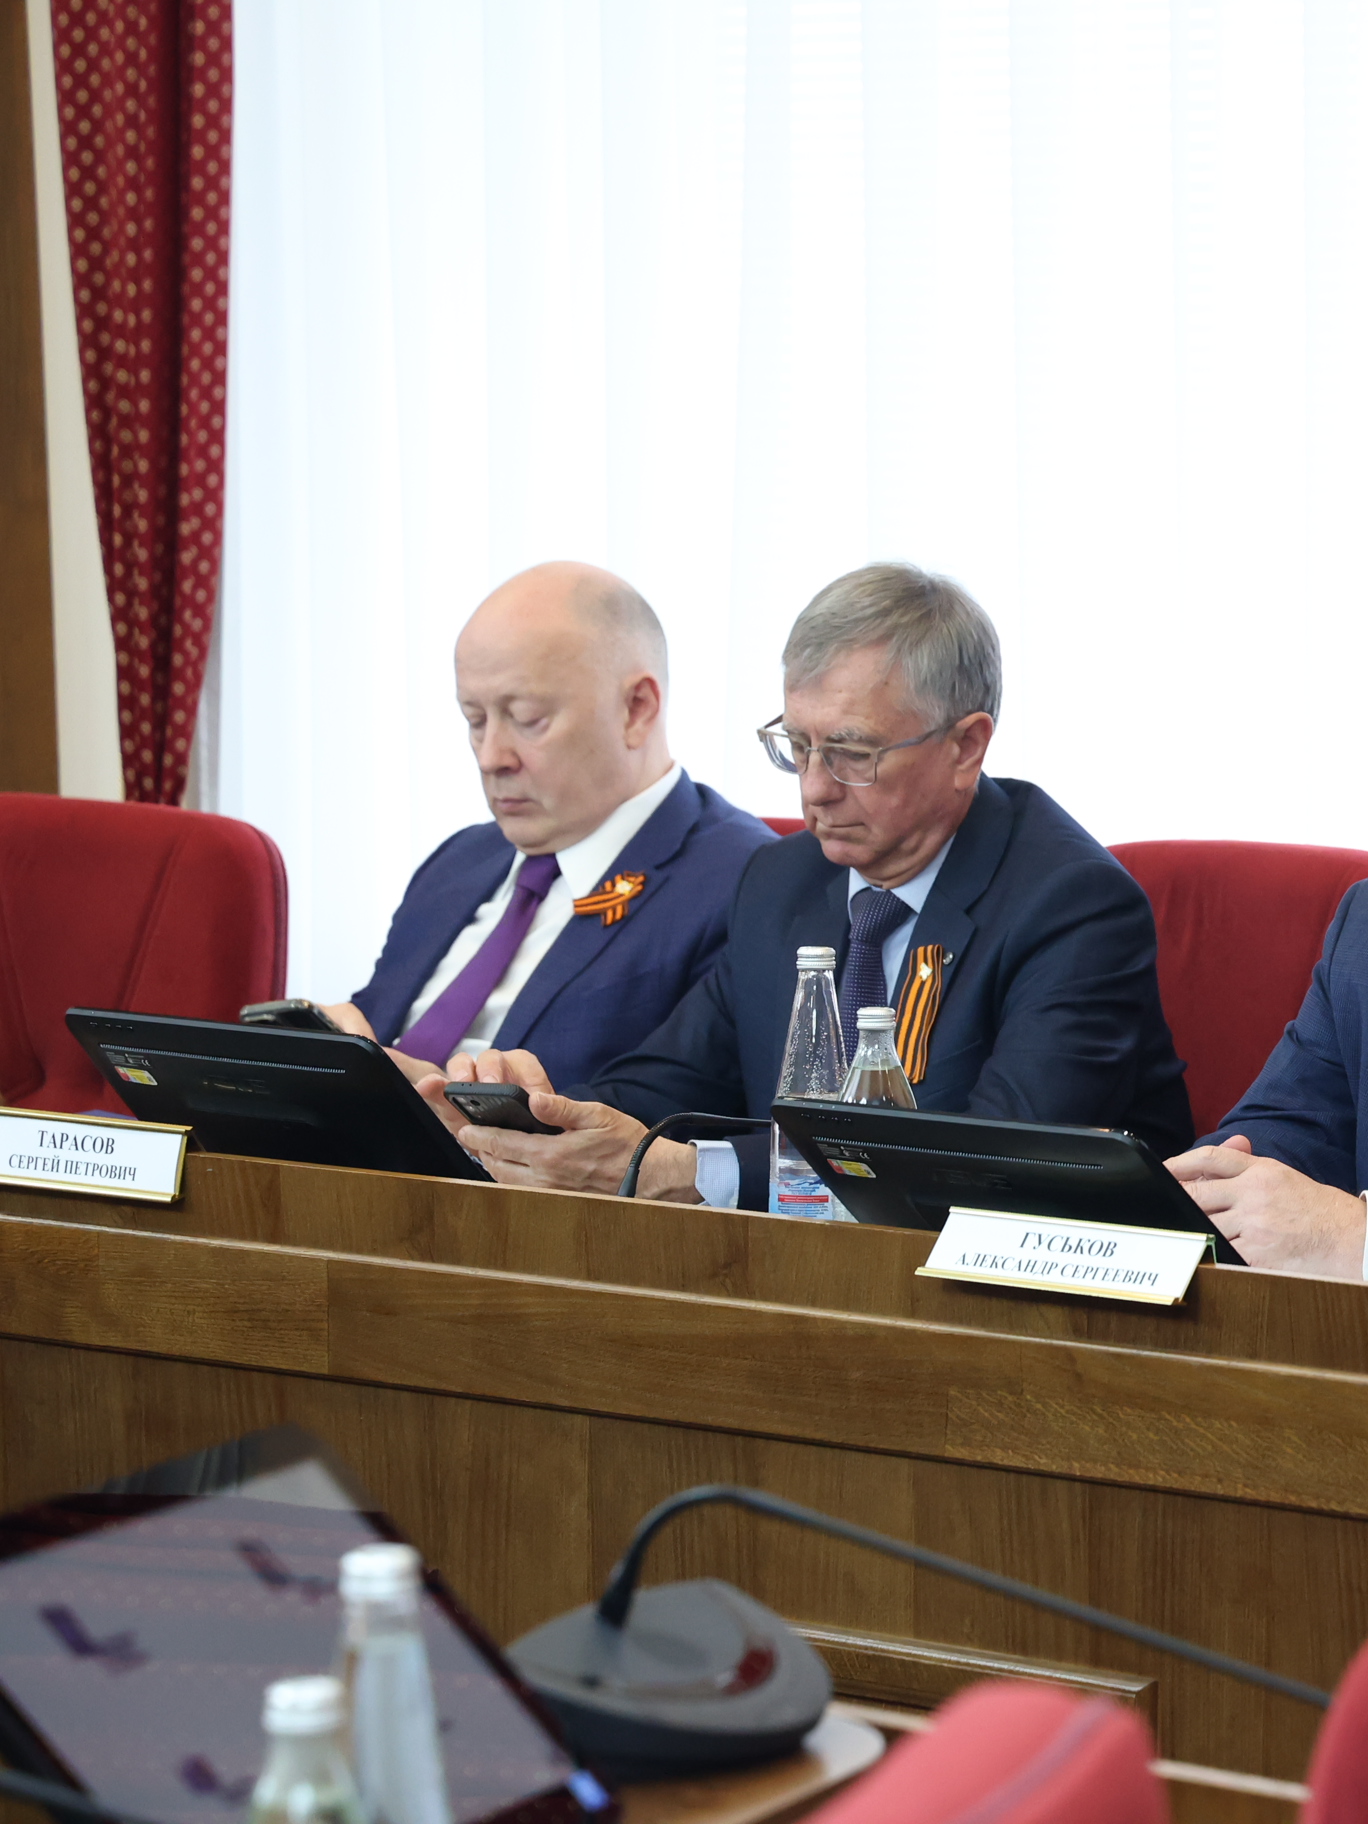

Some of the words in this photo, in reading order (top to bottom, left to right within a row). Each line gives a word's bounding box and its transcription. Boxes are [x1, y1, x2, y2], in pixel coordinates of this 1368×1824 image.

[38, 1129, 116, 1155] ТАРАСОВ
[8, 1153, 61, 1173] СЕРГЕЙ
[64, 1159, 138, 1182] ПЕТРОВИЧ
[1018, 1231, 1118, 1258] ГУСЬКОВ
[955, 1252, 1059, 1277] АЛЕКСАНДР
[1060, 1263, 1160, 1287] СЕРГЕЕВИЧ
